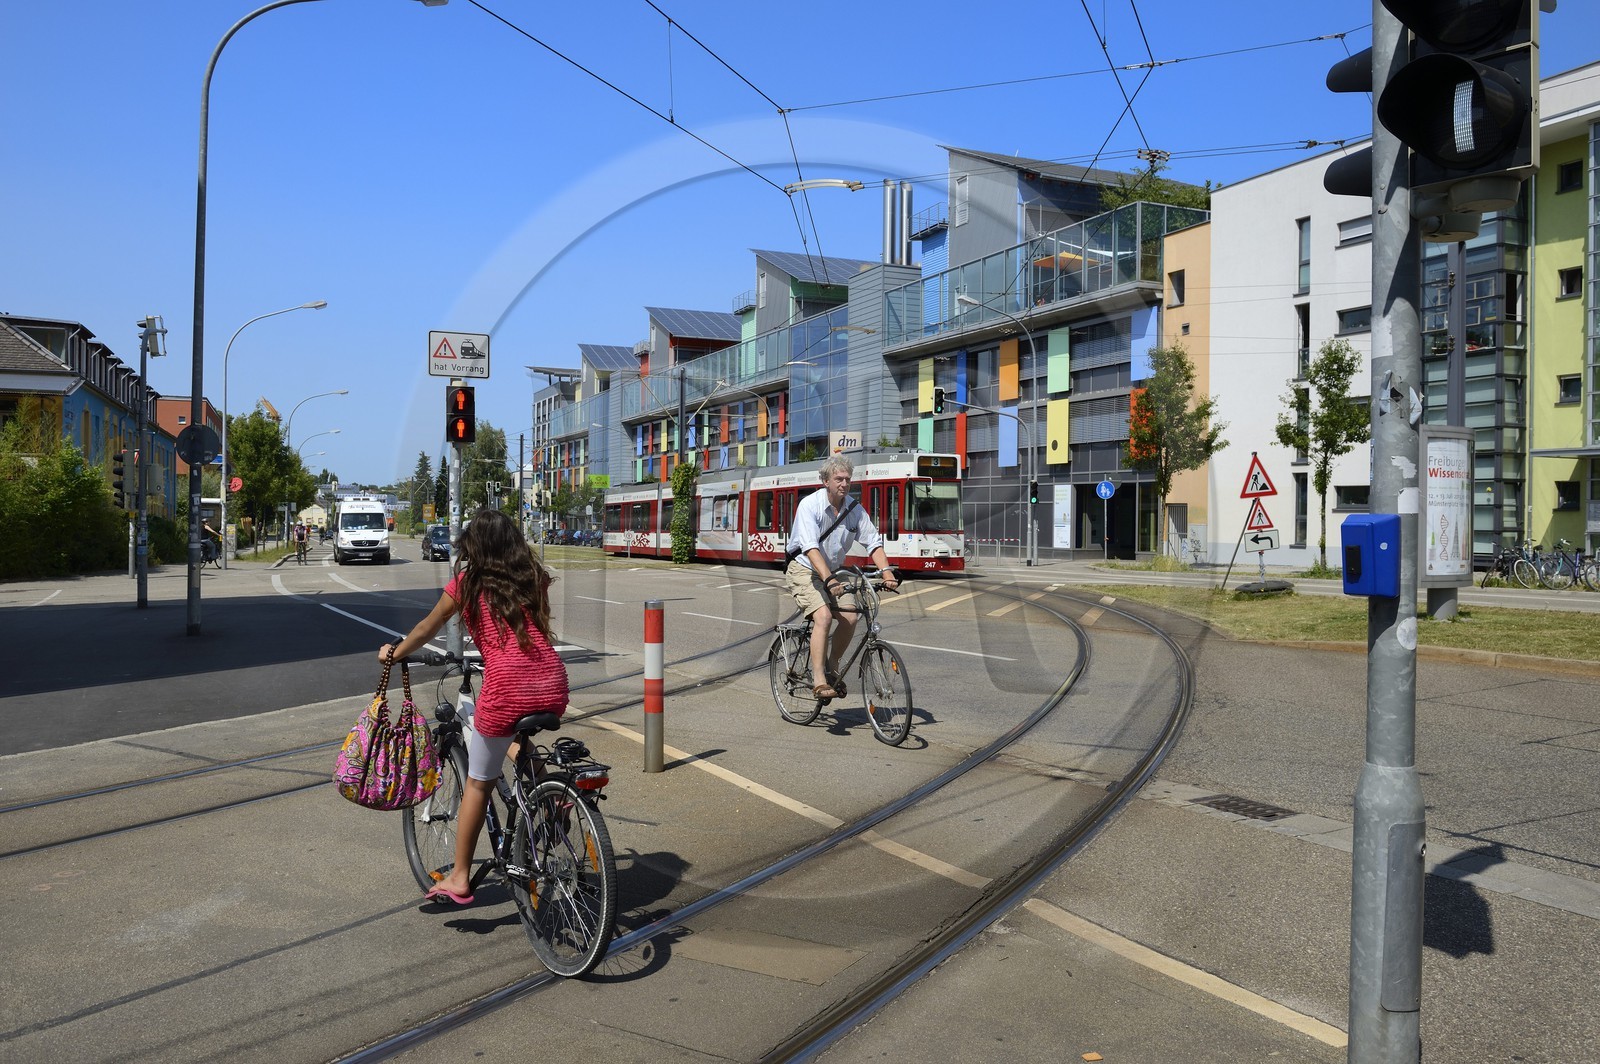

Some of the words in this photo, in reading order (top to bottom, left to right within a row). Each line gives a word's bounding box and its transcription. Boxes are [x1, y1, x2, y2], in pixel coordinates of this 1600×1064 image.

[434, 362, 447, 371] hat
[451, 363, 485, 375] Vorrang
[837, 434, 857, 447] dm
[889, 454, 899, 462] 247
[924, 561, 936, 569] 247
